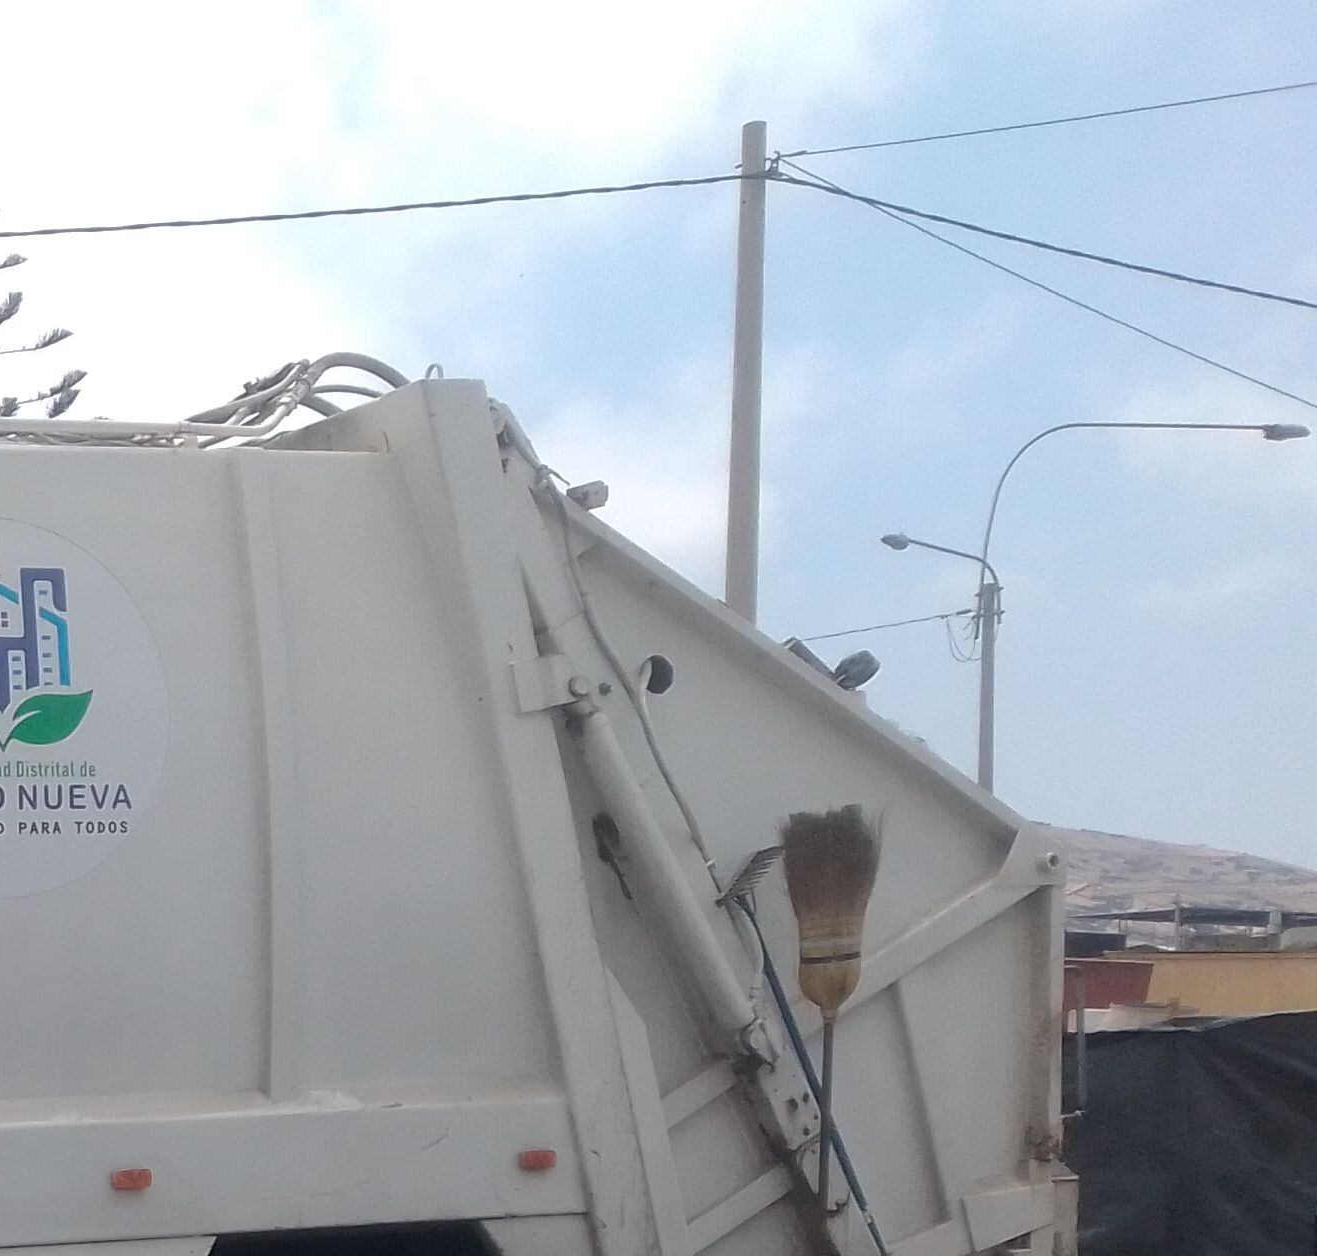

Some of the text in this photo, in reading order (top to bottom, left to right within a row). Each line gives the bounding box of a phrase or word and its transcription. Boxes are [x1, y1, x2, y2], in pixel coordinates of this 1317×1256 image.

[16, 761, 75, 777] Distrital
[80, 761, 96, 776] de
[18, 784, 133, 810] NUEVA
[18, 822, 61, 834] PARA
[75, 821, 129, 834] TODOS
